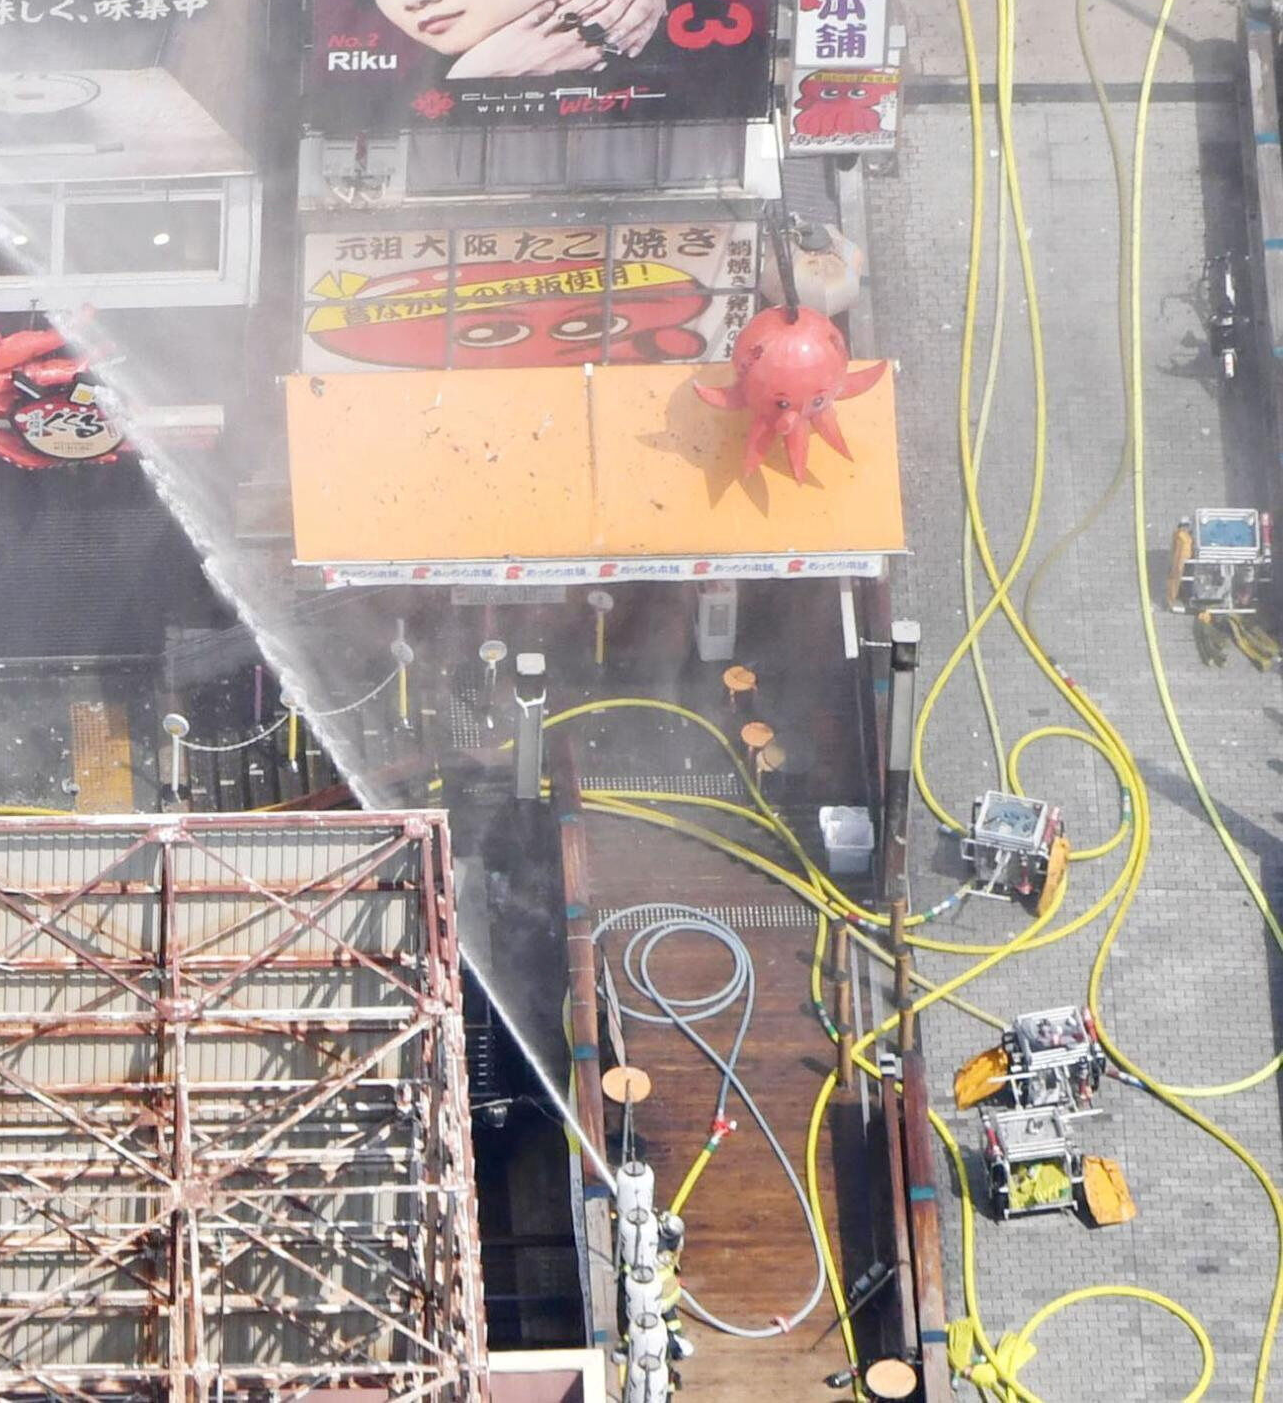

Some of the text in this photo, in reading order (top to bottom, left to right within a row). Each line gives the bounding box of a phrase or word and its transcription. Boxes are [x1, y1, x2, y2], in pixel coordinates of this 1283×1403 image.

[328, 51, 397, 72] Riku
[335, 227, 718, 261] 元祖大阪たこ焼き
